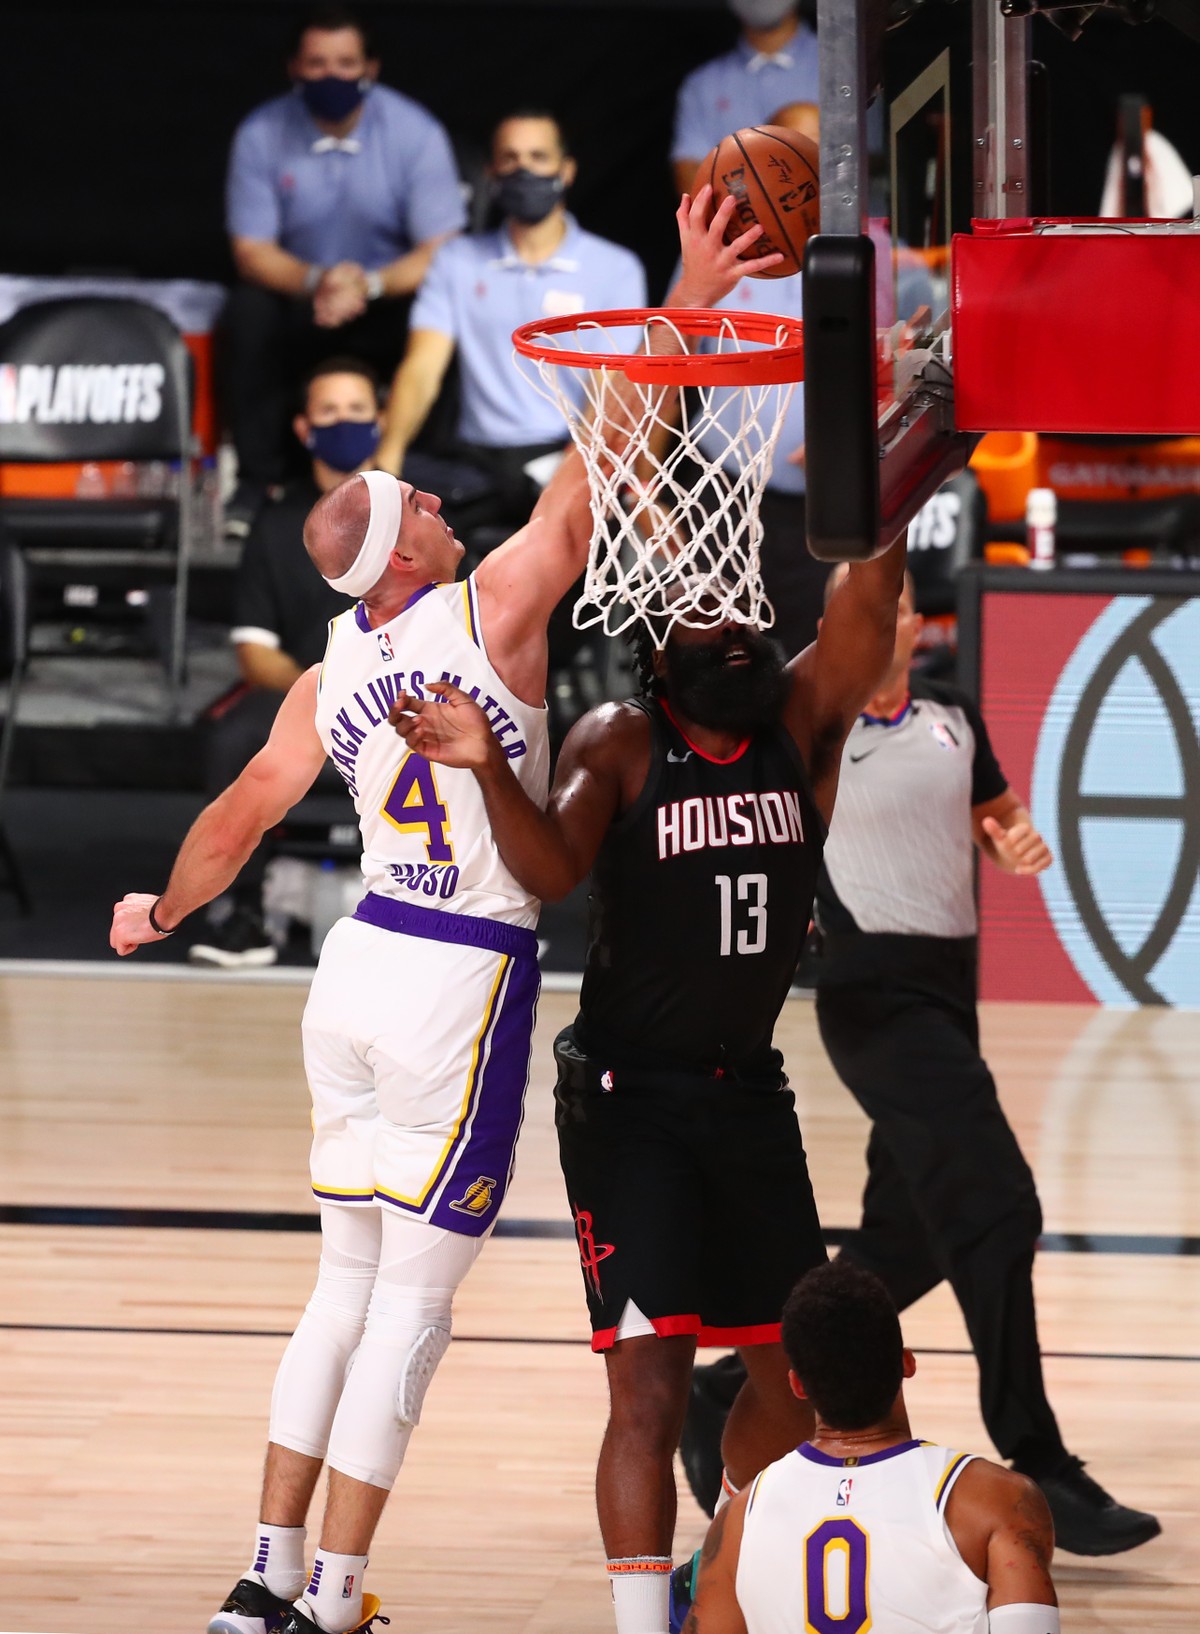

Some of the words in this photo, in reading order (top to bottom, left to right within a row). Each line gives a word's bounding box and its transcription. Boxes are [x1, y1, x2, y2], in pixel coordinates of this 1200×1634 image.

[16, 363, 165, 424] PLAYOFFS
[379, 750, 455, 865] 4
[657, 791, 804, 861] HOUSTON
[715, 873, 768, 956] 13
[803, 1515, 872, 1634] 0
